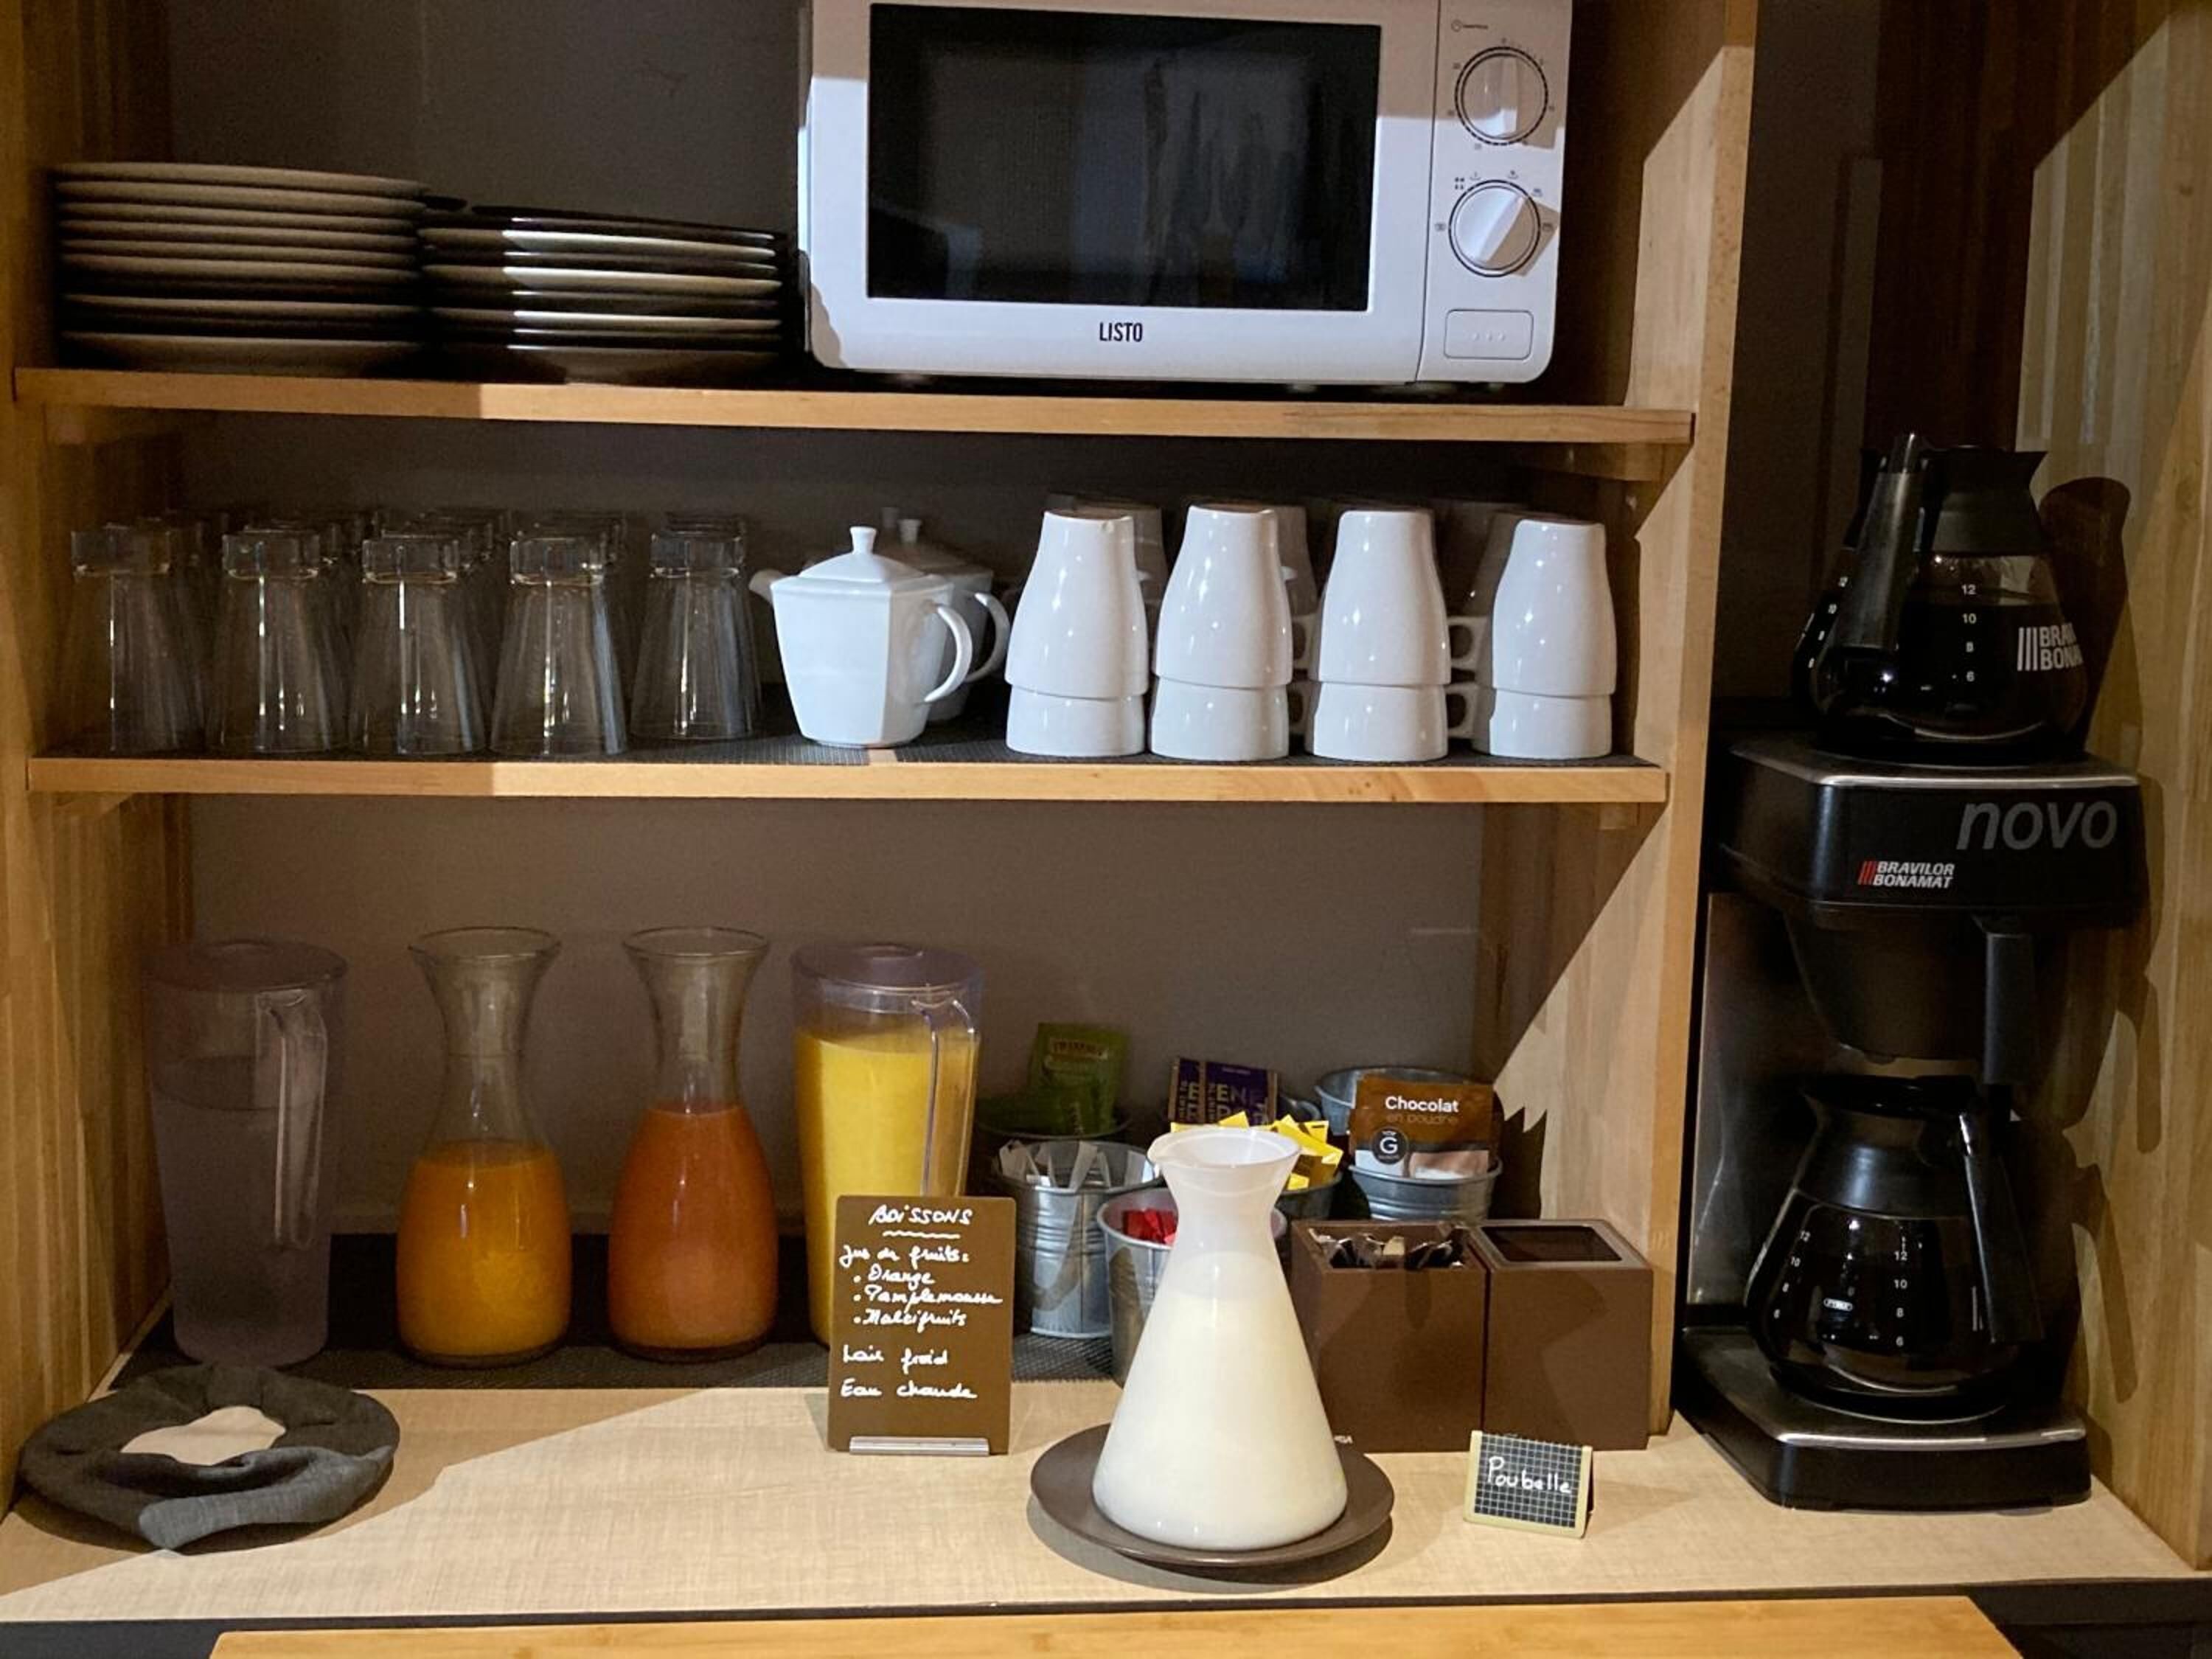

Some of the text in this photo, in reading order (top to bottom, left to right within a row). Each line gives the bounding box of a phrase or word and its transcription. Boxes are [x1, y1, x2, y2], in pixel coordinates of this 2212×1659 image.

[1099, 321, 1142, 342] LISTO
[1961, 584, 1977, 595] 12
[1962, 613, 1977, 624] 10
[1966, 642, 1975, 653] 8
[1966, 671, 1975, 682] 6
[1956, 800, 2118, 850] novo
[1877, 860, 1955, 876] BRAVILOR
[1872, 874, 1954, 888] BONAMAT
[1385, 1094, 1459, 1113] Chocolat
[1380, 1136, 1398, 1154] G
[1893, 1251, 1908, 1262] 12
[1893, 1279, 1908, 1289] 10
[1896, 1307, 1905, 1318] 8
[1896, 1336, 1905, 1347] 6
[900, 1347, 950, 1375] froid
[841, 1377, 979, 1399] Eau chaude
[1486, 1455, 1572, 1494] Poubelle
